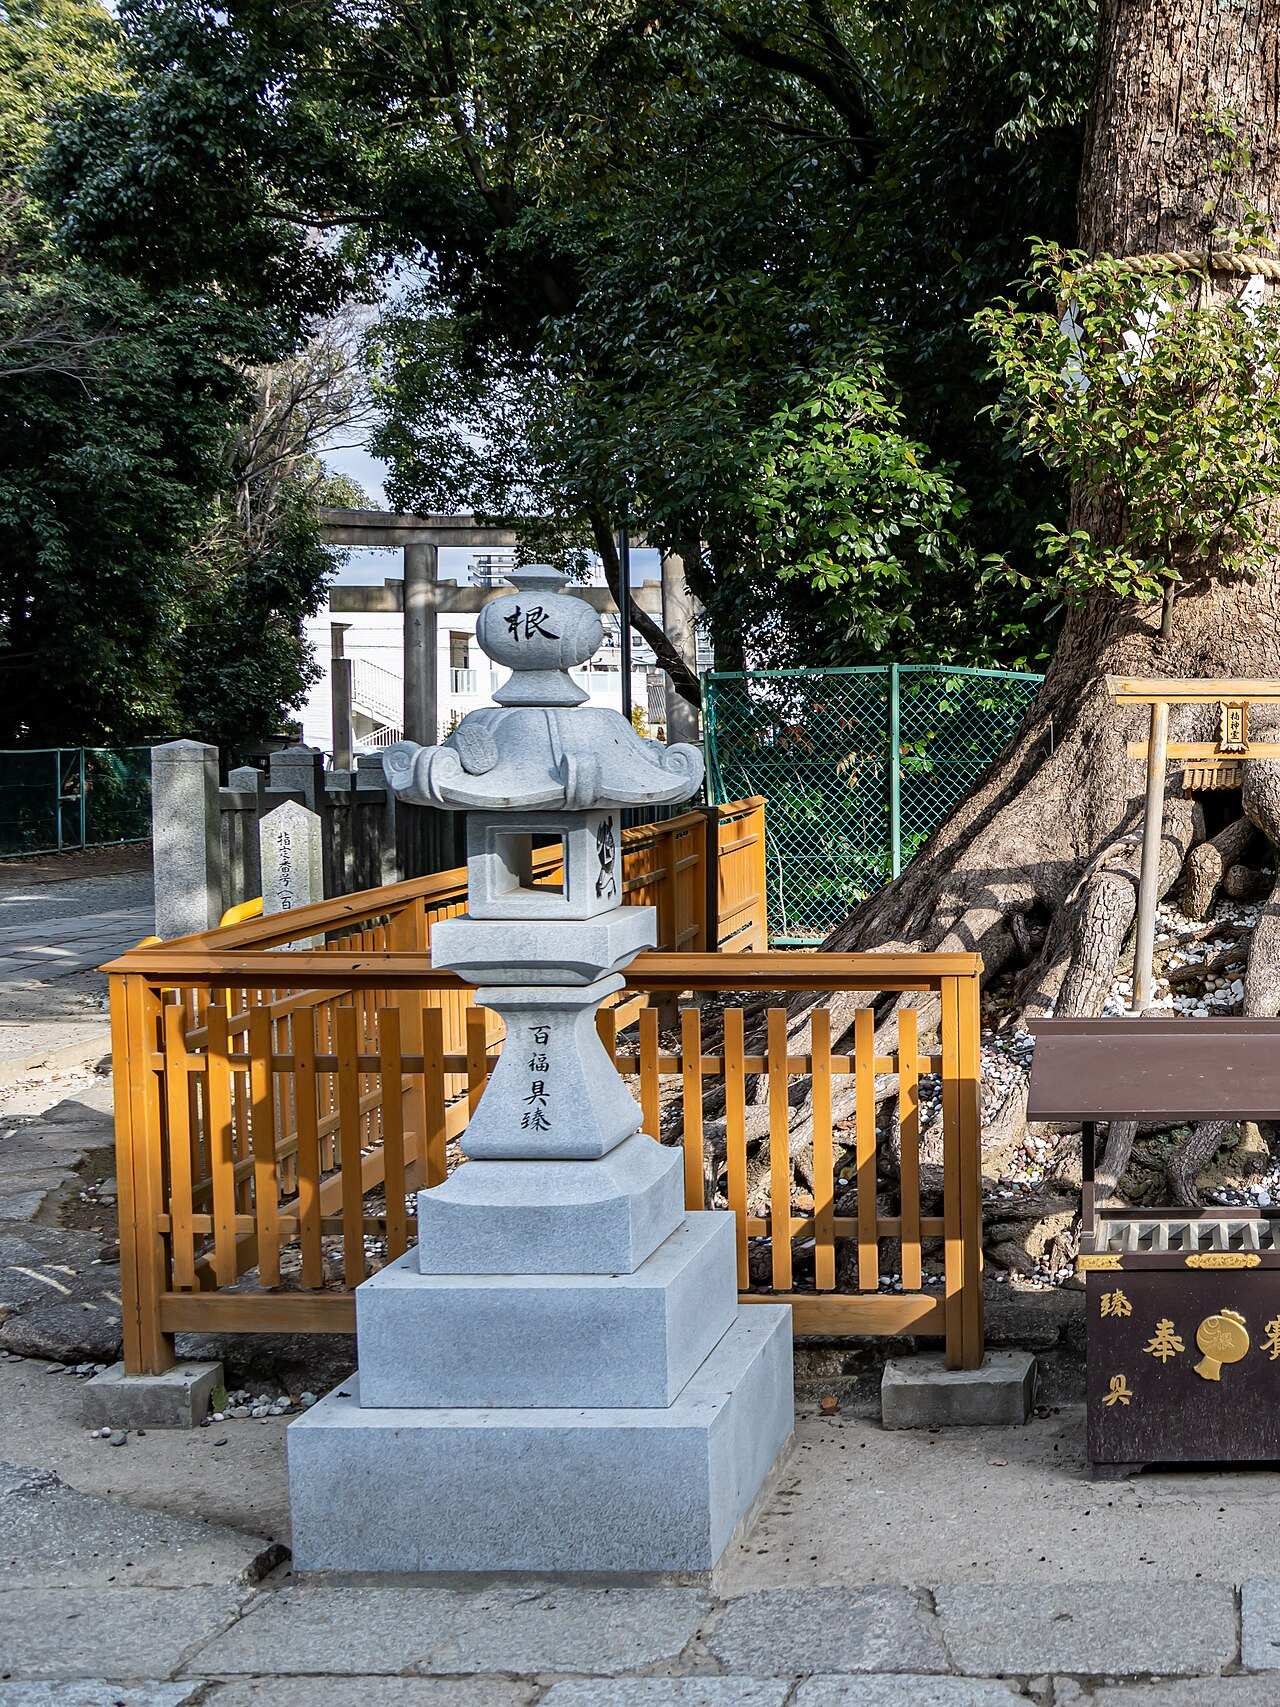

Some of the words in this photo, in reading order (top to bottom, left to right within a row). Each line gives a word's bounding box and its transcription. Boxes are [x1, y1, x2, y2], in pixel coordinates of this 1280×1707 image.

[504, 605, 560, 642] 根
[520, 1025, 552, 1132] 百福具臻
